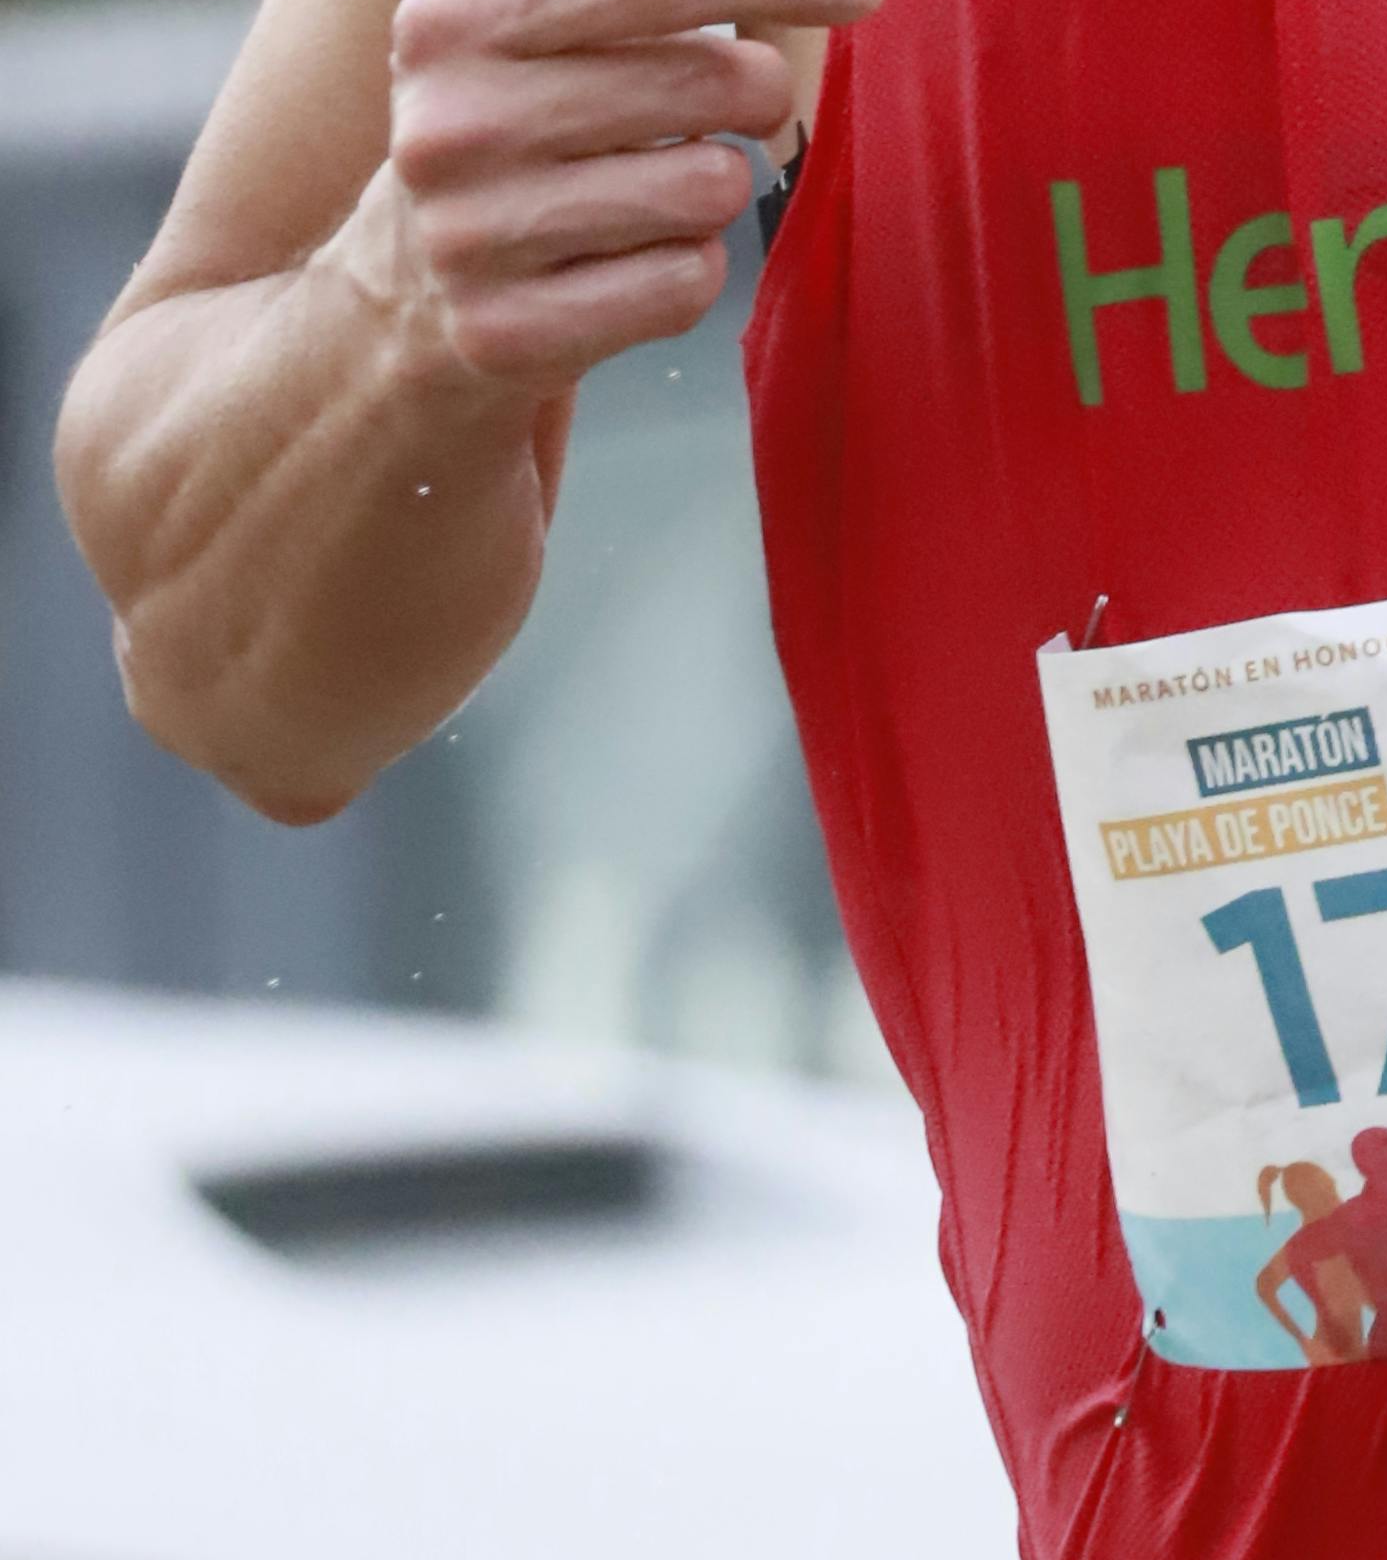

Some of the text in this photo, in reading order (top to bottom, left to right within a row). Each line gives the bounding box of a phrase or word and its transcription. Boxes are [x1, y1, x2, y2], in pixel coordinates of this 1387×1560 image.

[1093, 667, 1232, 708] MARATÓN
[1245, 656, 1280, 682] EN
[1197, 713, 1370, 789] MARATÓN
[1107, 786, 1387, 874] PLAYA DE PONCE
